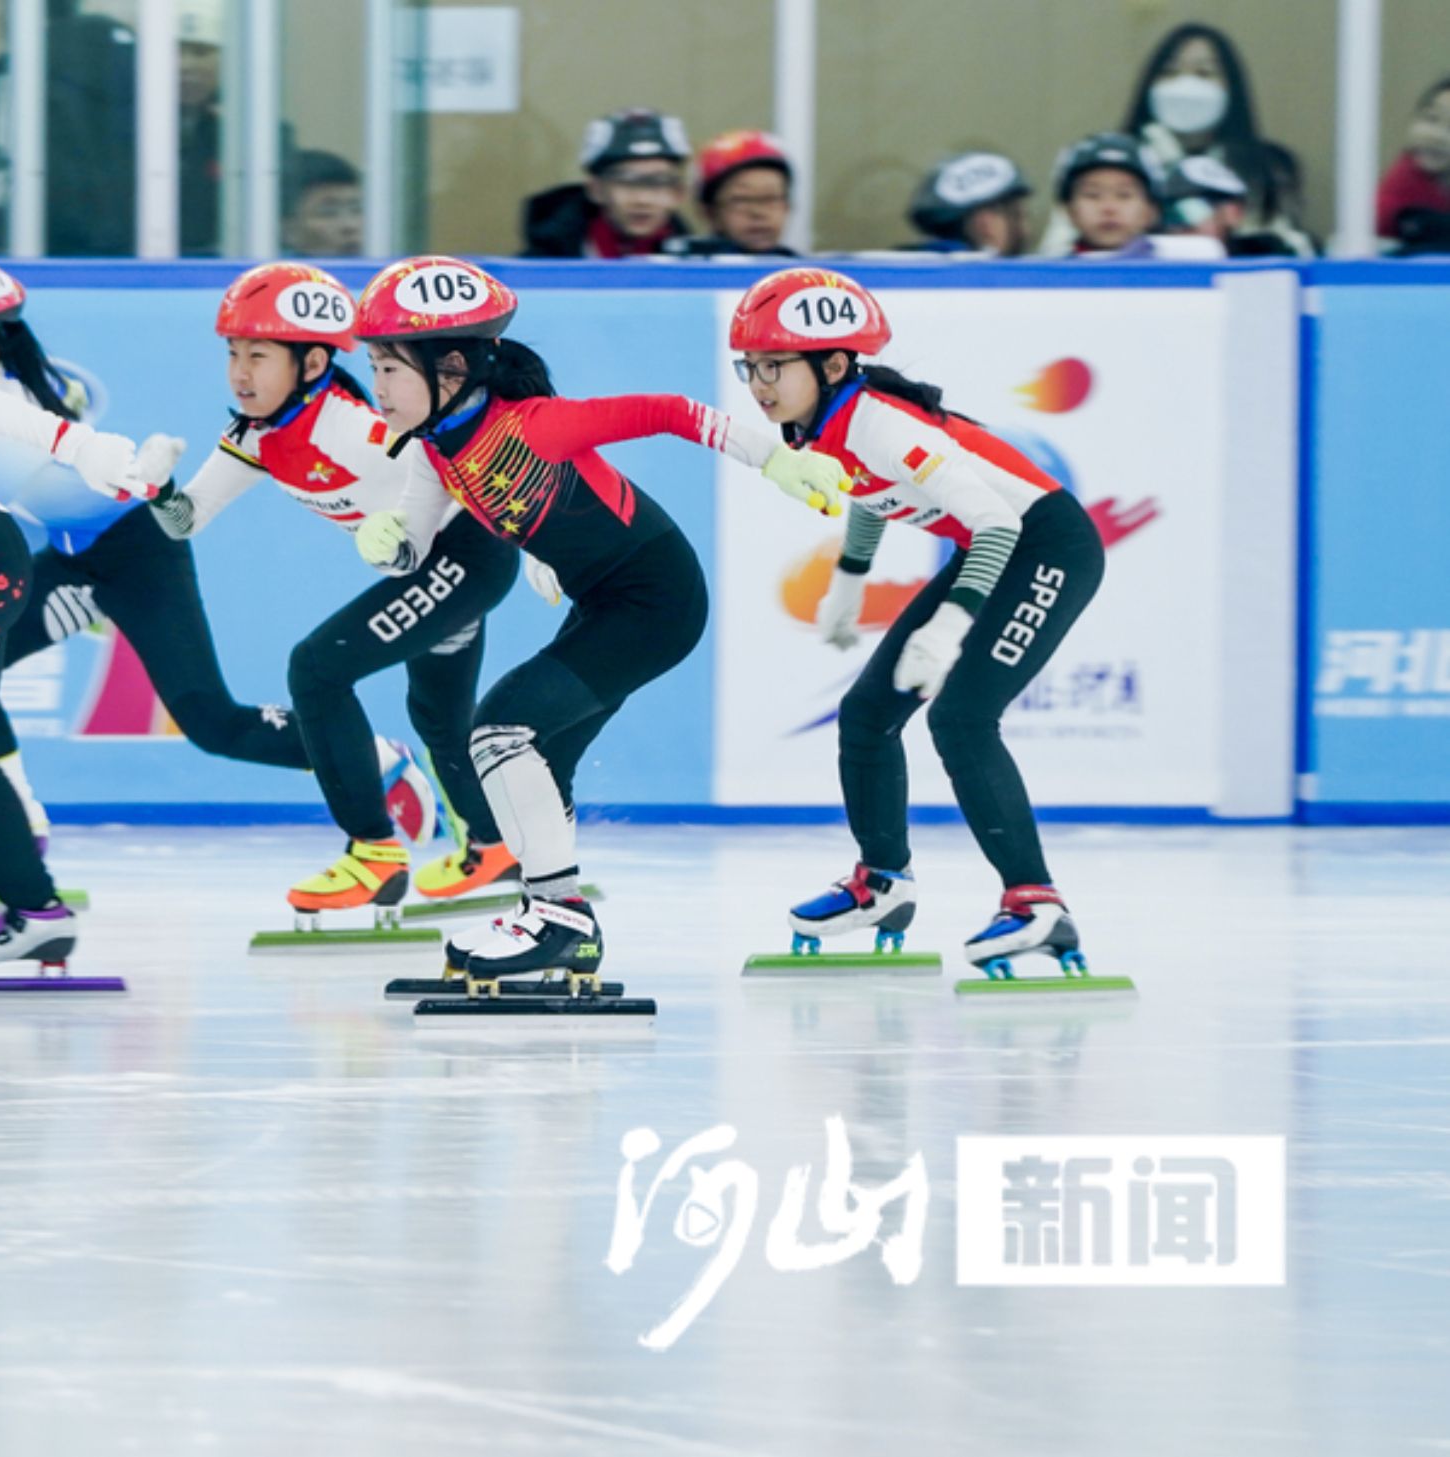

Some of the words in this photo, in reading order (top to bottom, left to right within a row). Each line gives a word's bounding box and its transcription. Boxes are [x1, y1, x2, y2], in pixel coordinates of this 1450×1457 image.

[409, 272, 478, 304] 105
[292, 290, 347, 323] 026
[794, 295, 858, 328] 104
[367, 555, 467, 643] SPEED
[990, 563, 1066, 668] SPEED
